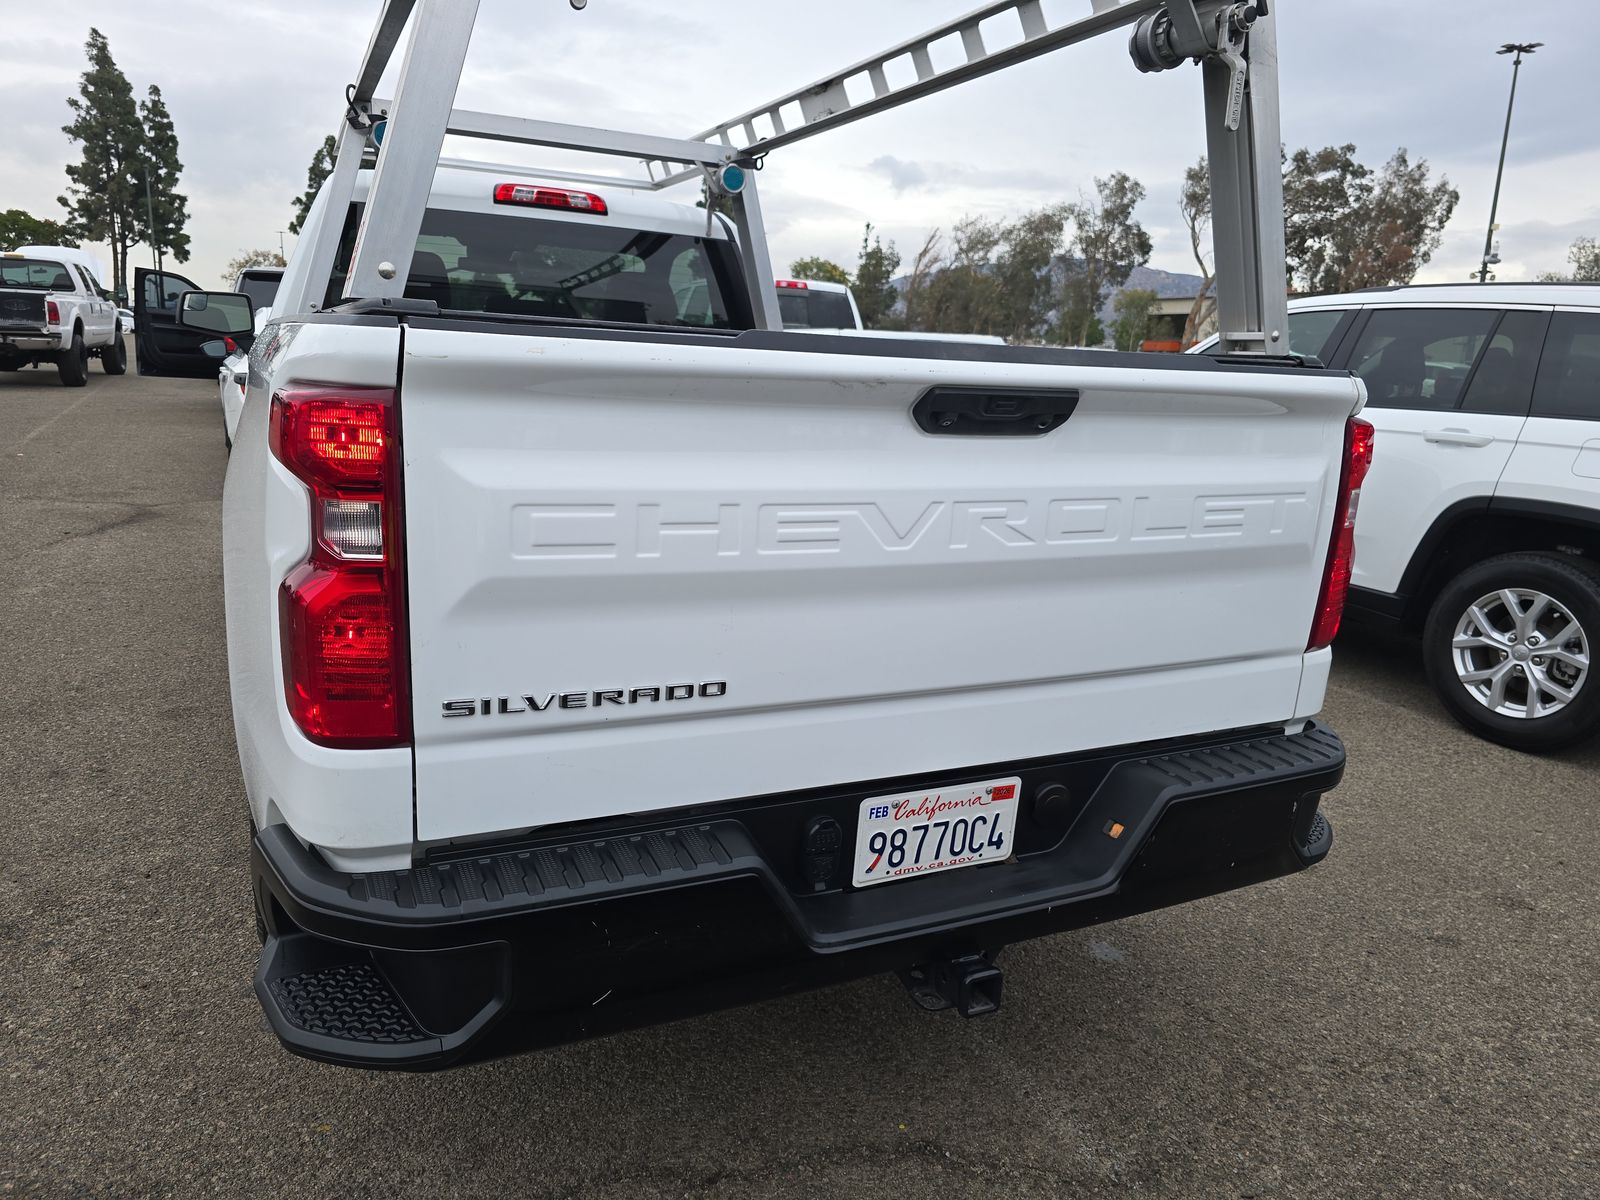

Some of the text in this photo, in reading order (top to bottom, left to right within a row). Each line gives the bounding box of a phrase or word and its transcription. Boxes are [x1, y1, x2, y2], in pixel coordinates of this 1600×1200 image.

[510, 491, 1307, 561] CHEVROLET
[441, 679, 728, 718] SILVERADO
[868, 805, 889, 820] FEB
[894, 794, 992, 821] California
[865, 812, 1004, 874] 98770C4
[893, 855, 976, 876] dmv.ca.gov
